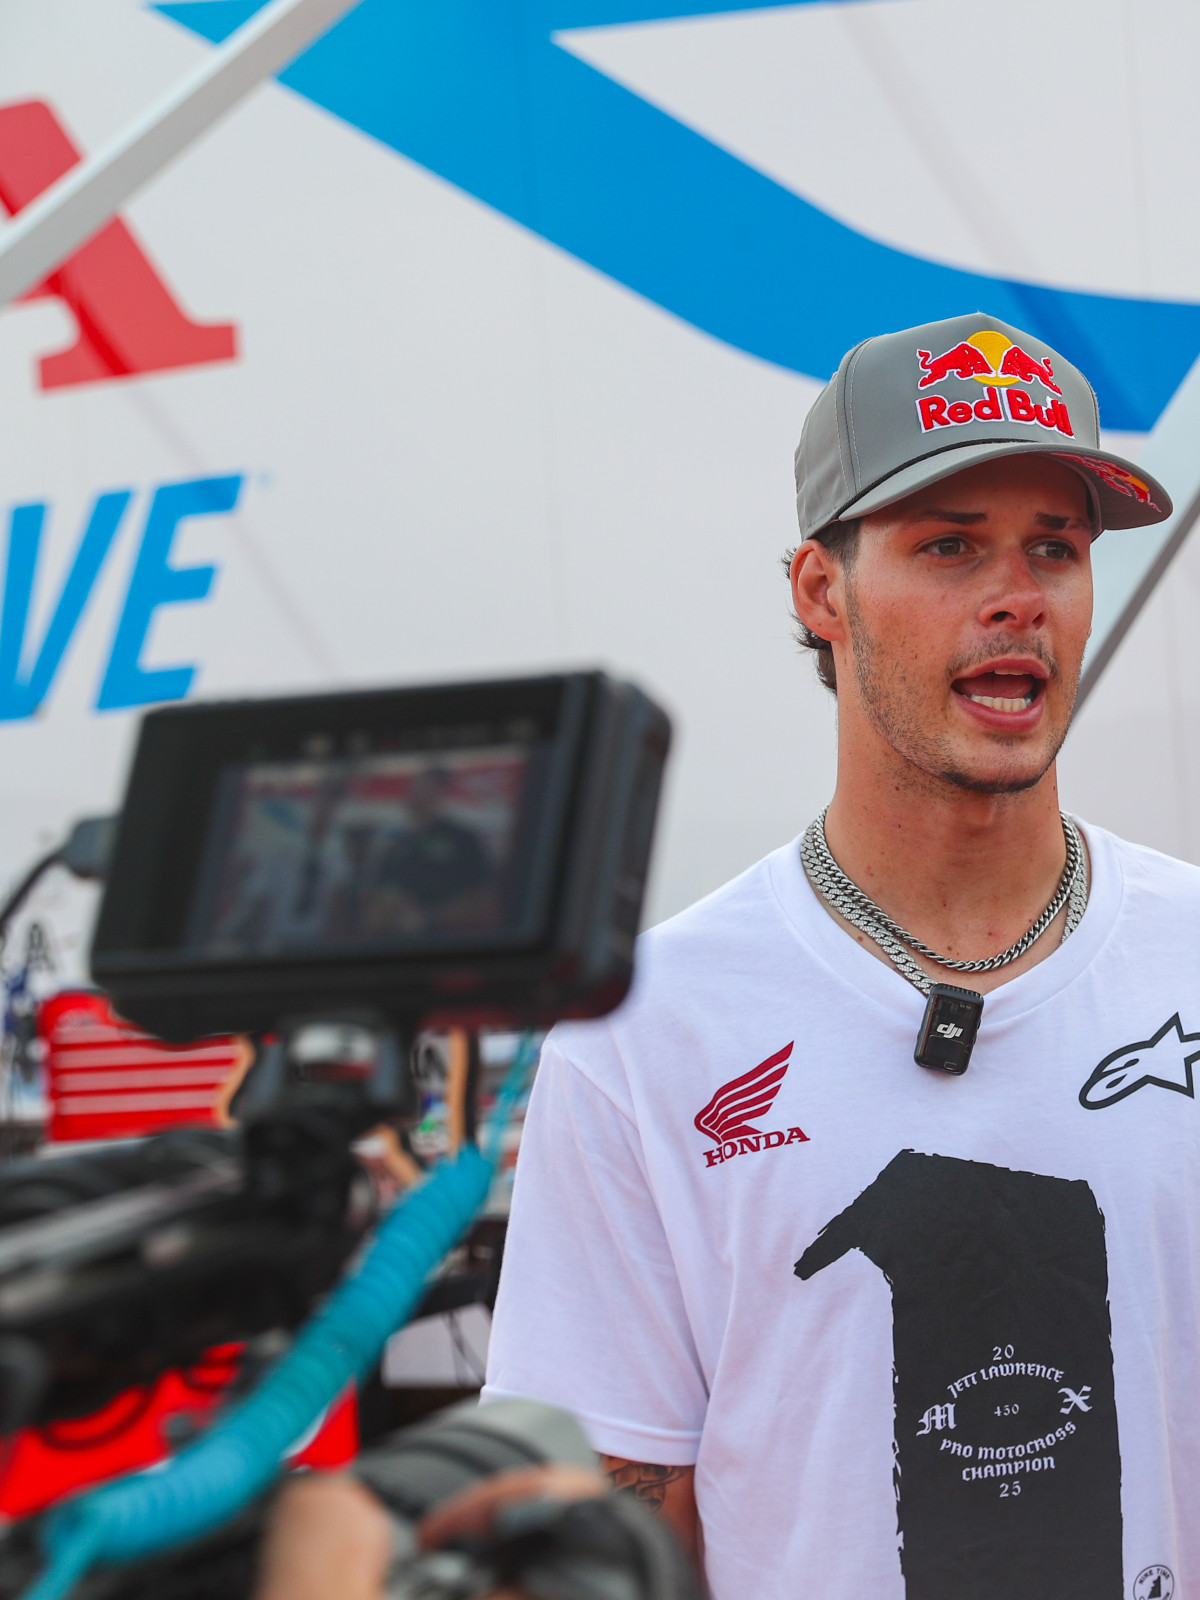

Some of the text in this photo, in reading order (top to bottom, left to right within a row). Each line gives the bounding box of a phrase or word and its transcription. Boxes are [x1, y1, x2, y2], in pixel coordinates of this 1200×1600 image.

[915, 387, 1076, 440] Red Bull
[702, 1126, 811, 1168] HONDA
[992, 1344, 1015, 1361] 20
[947, 1362, 1065, 1399] JETT LAWRENCE
[915, 1385, 1093, 1436] M 450 X
[940, 1421, 1077, 1460] PRO MOTOCROSS
[962, 1456, 1056, 1482] CHAMPION
[999, 1480, 1022, 1498] 25
